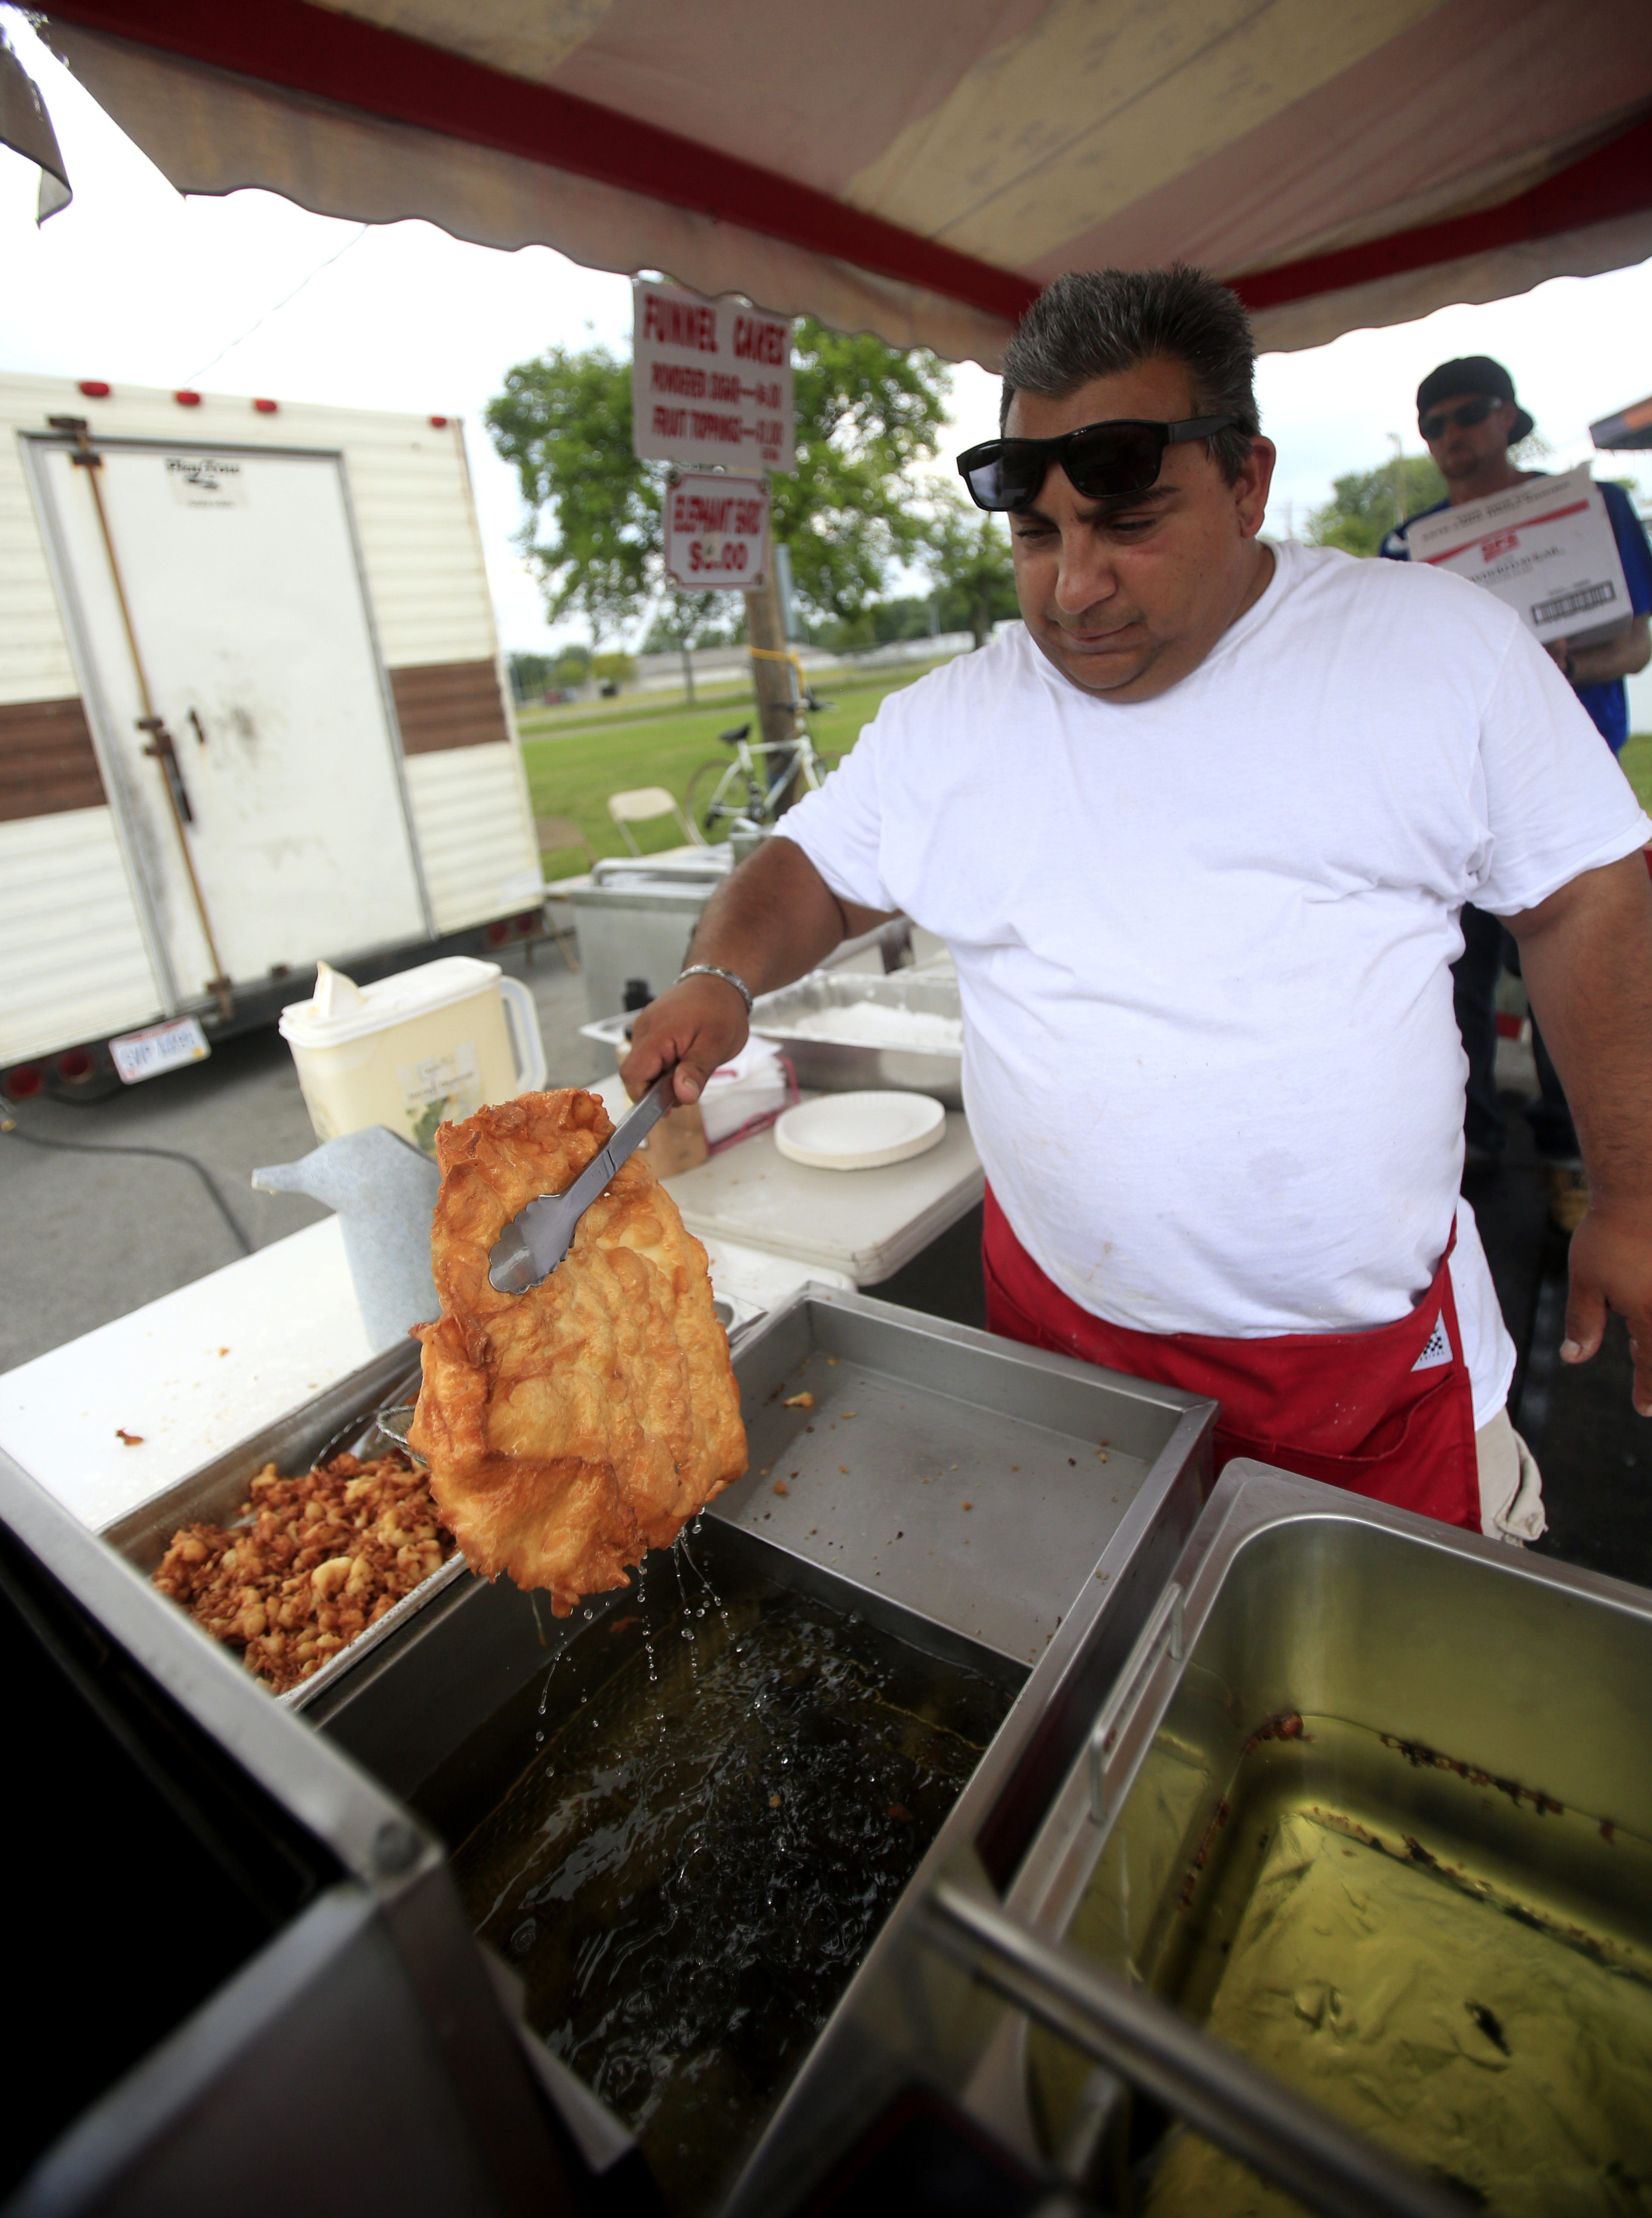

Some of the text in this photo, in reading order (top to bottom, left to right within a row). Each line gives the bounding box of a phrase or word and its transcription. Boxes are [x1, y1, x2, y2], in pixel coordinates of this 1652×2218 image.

[644, 293, 786, 366] FUNNEL CAKES
[652, 405, 687, 438] FRUIT
[687, 539, 749, 572] $.00
